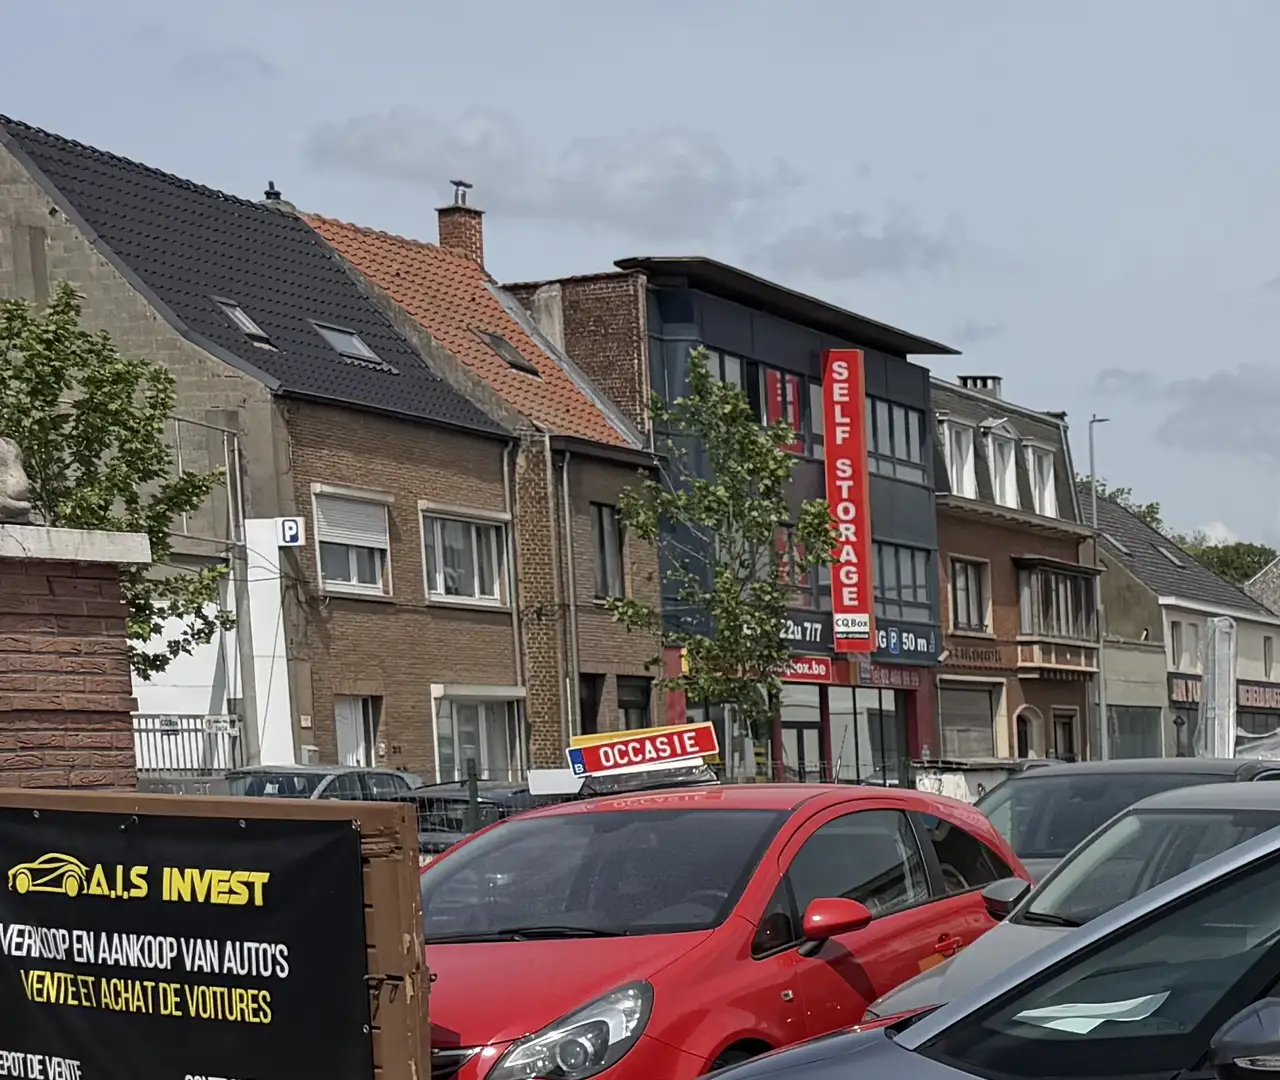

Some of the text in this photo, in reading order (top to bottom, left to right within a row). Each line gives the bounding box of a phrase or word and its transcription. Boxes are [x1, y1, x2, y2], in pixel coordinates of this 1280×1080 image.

[831, 361, 850, 444] SELF
[283, 520, 297, 542] P
[835, 459, 859, 605] STORAGE
[902, 632, 916, 651] 50
[917, 638, 928, 652] m
[574, 763, 584, 773] B
[599, 731, 699, 767] OCCASIE
[88, 863, 270, 906] A.I.S INVEST
[0, 923, 290, 979] VERKOOP EN AANKOOP VAN AUTO'S
[20, 969, 272, 1024] VENTE ET ACHAT DE VOITURES
[27, 1054, 44, 1080] DE
